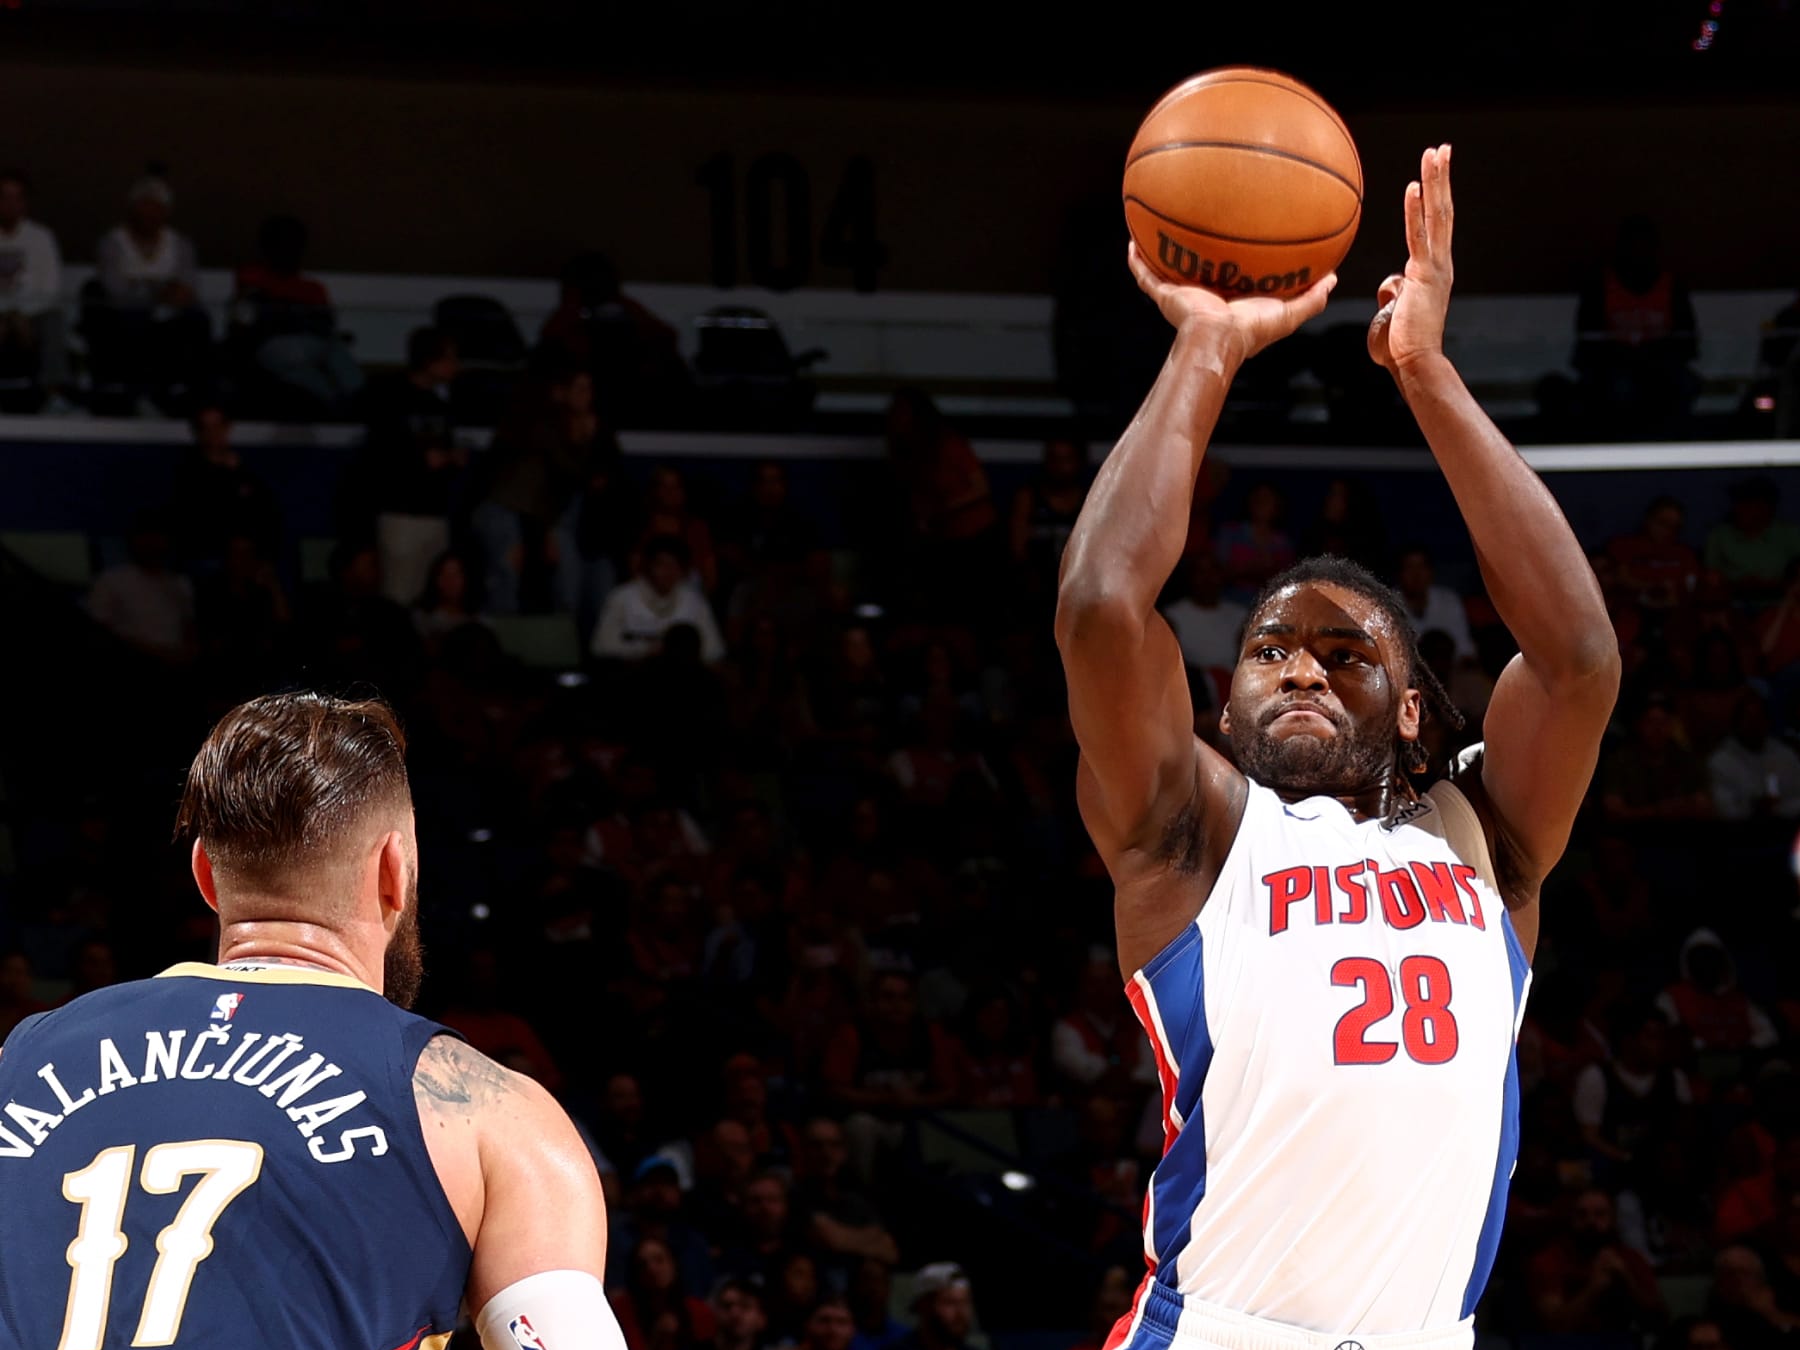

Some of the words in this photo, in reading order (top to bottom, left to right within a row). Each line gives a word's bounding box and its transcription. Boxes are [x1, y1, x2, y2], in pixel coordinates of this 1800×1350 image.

[695, 152, 889, 290] 104
[1156, 230, 1312, 294] Wilson
[1330, 955, 1459, 1066] 28
